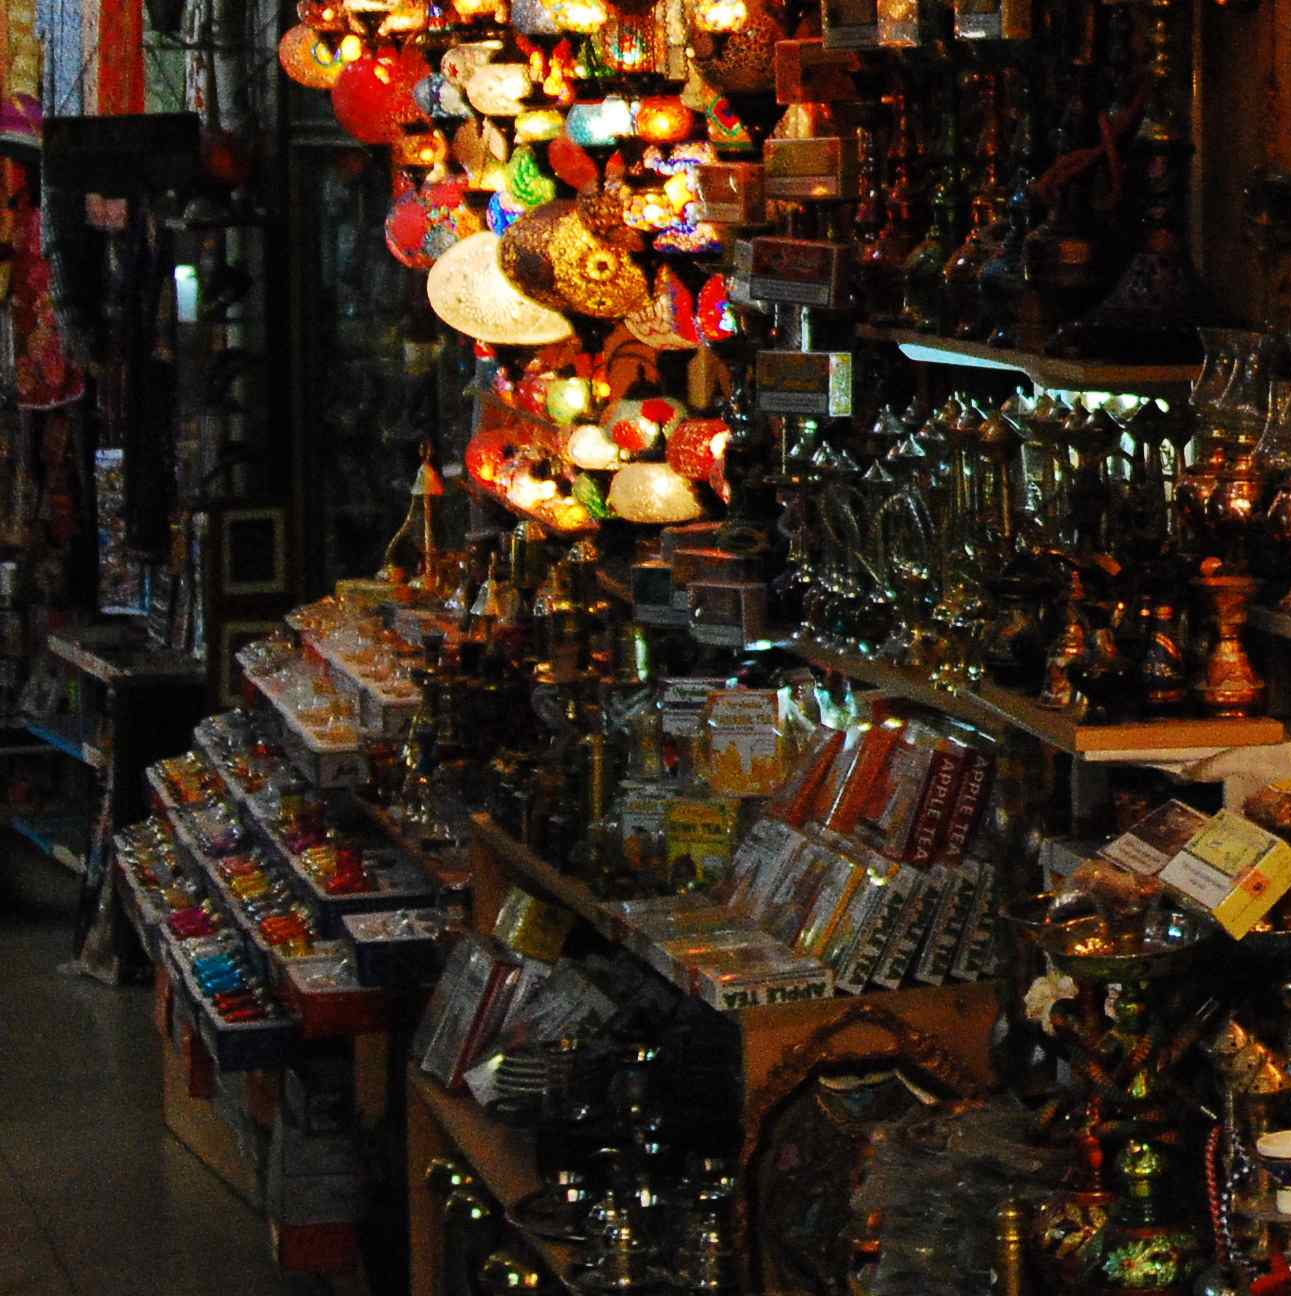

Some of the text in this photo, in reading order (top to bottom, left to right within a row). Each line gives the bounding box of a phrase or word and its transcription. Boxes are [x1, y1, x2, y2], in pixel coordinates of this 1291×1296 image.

[912, 757, 956, 862] APPLE TEA
[959, 754, 991, 818] APPLE
[946, 821, 970, 857] TEA
